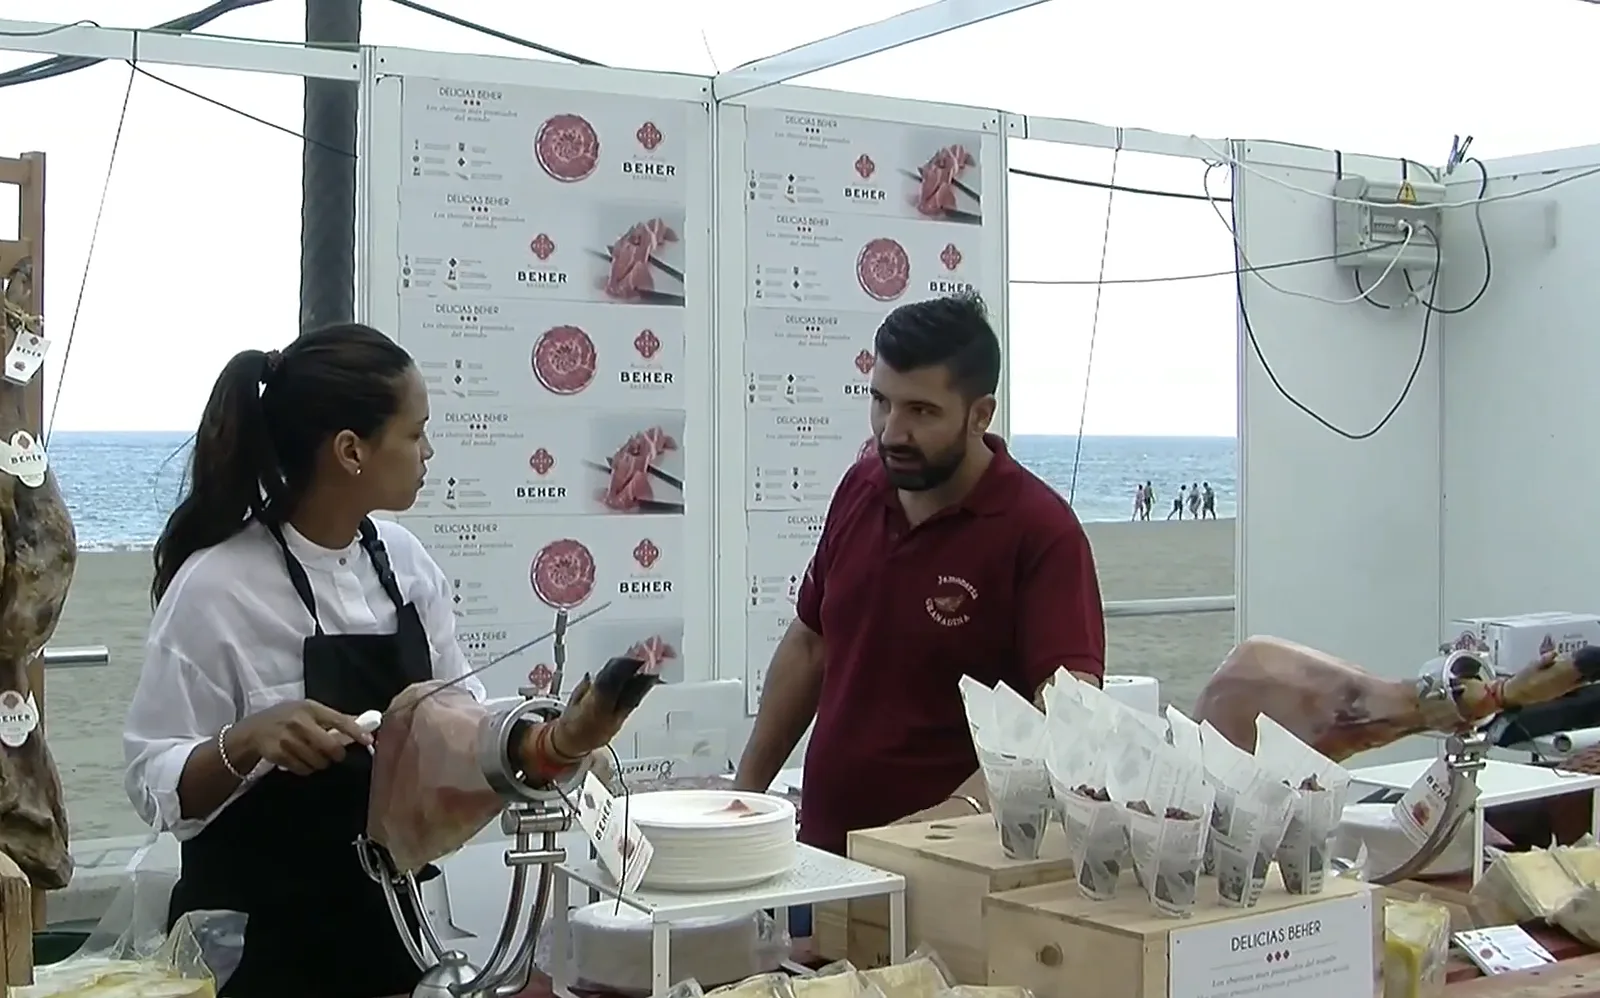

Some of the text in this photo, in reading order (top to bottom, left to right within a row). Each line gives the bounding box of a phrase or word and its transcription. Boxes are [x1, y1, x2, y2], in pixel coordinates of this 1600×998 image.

[439, 87, 502, 100] DELICIAS BEHER
[623, 161, 676, 176] BEHER
[844, 187, 886, 201] BEHER
[518, 270, 568, 284] BEHER
[621, 371, 673, 384] BEHER
[445, 412, 509, 423] DELICIAS BEHER
[516, 487, 566, 498] BEHER
[434, 523, 498, 534] DELICIAS BEHER
[620, 581, 672, 594] BEHER
[0, 714, 30, 723] EHER
[1231, 920, 1322, 952] DELICIAS BEHER
